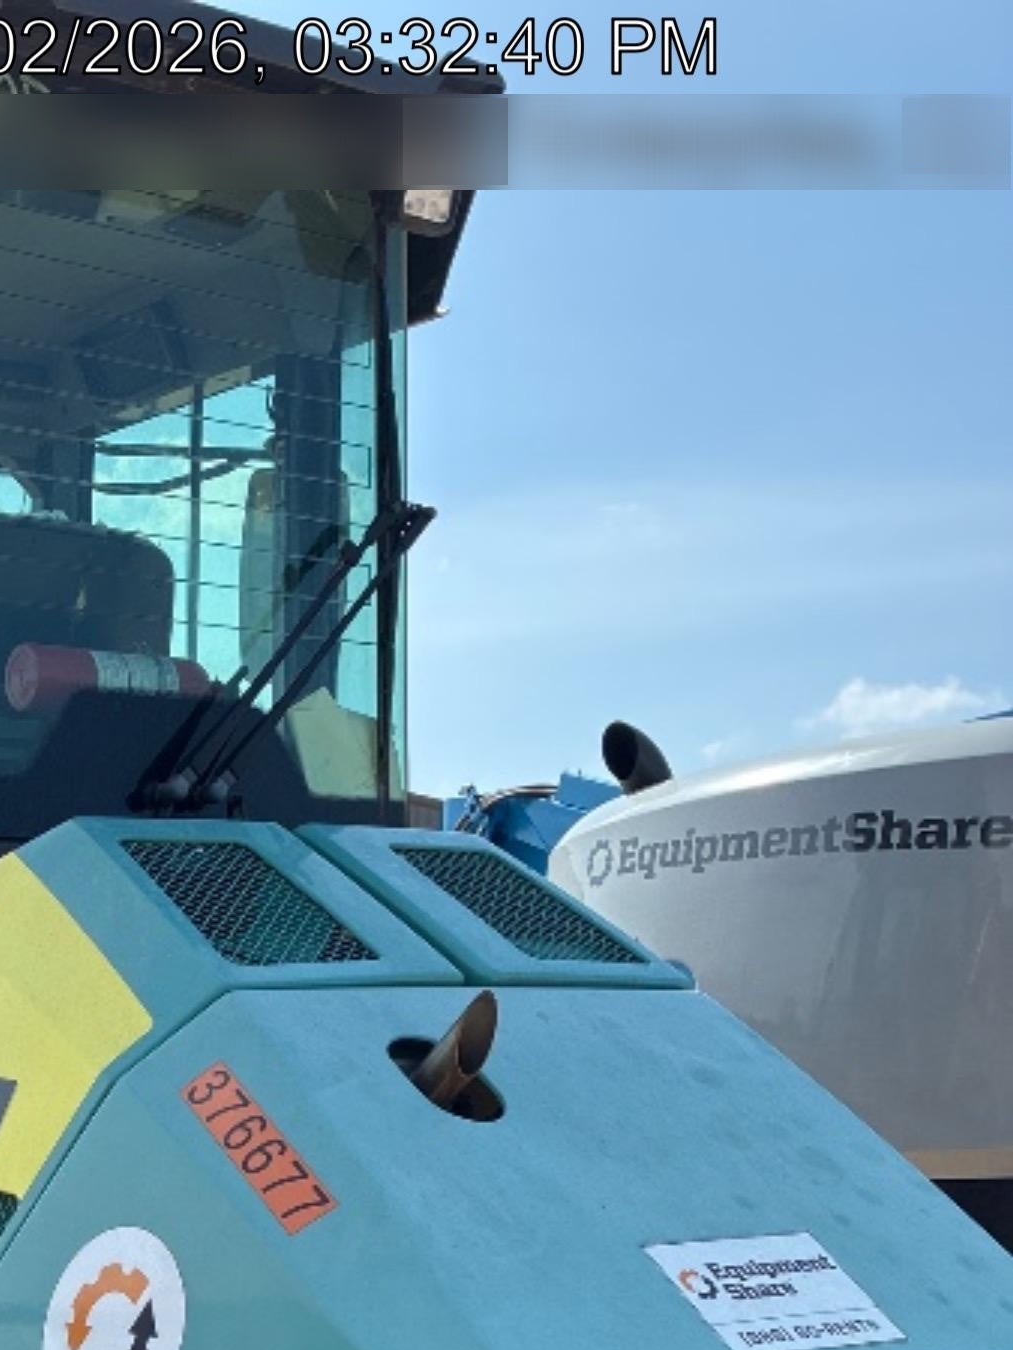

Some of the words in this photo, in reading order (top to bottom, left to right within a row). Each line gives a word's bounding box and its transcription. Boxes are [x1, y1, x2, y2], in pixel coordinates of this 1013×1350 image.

[617, 809, 1013, 880] EquipmentShare
[187, 1069, 330, 1220] 376677
[703, 1254, 837, 1281] Equipment
[722, 1280, 798, 1301] Share
